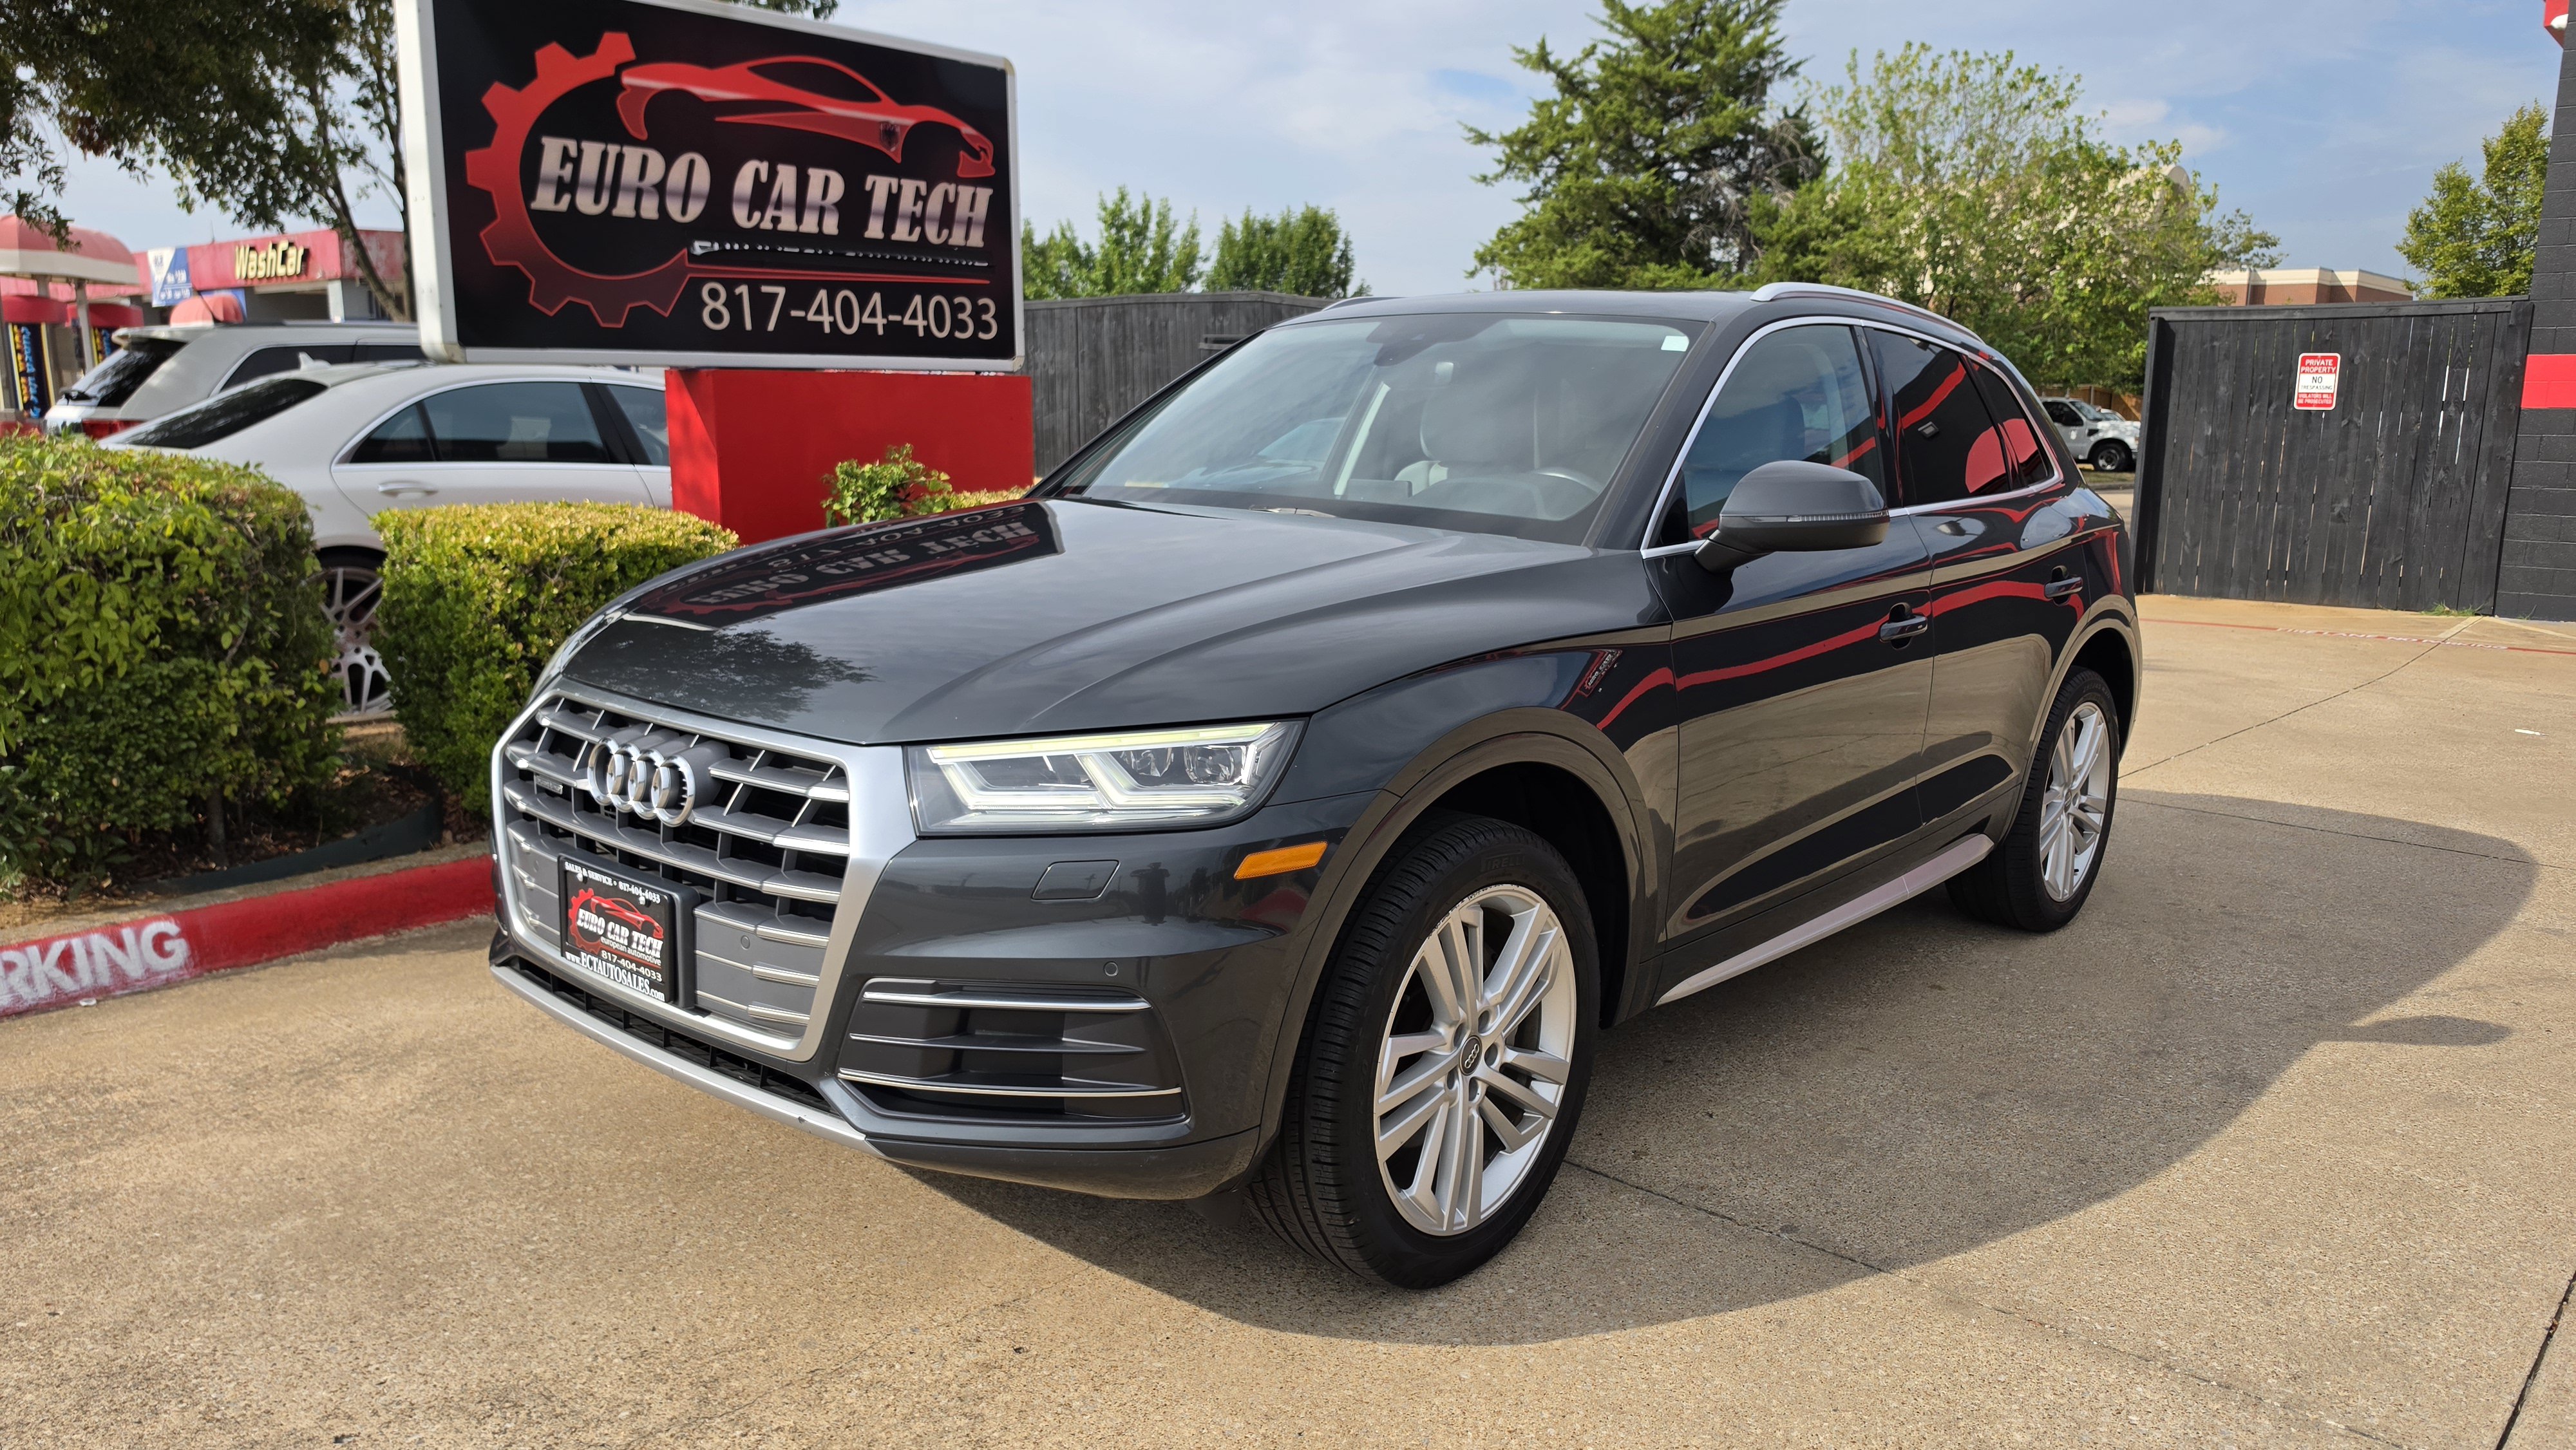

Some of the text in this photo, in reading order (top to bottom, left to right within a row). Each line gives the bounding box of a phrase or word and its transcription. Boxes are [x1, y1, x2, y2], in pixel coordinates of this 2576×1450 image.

[530, 136, 994, 249] EURO CAR TECH
[235, 239, 305, 280] WashCar
[700, 281, 999, 341] 817-404-4033
[565, 861, 583, 874] SALES
[587, 869, 612, 887] SERVICE
[618, 881, 661, 904] 817-404-4033
[576, 908, 664, 958] EURO CAR TECH
[600, 936, 662, 966] european automotive
[565, 951, 665, 1003] www.ECTAUTOSALES.com
[601, 950, 663, 983] 817-404-4033
